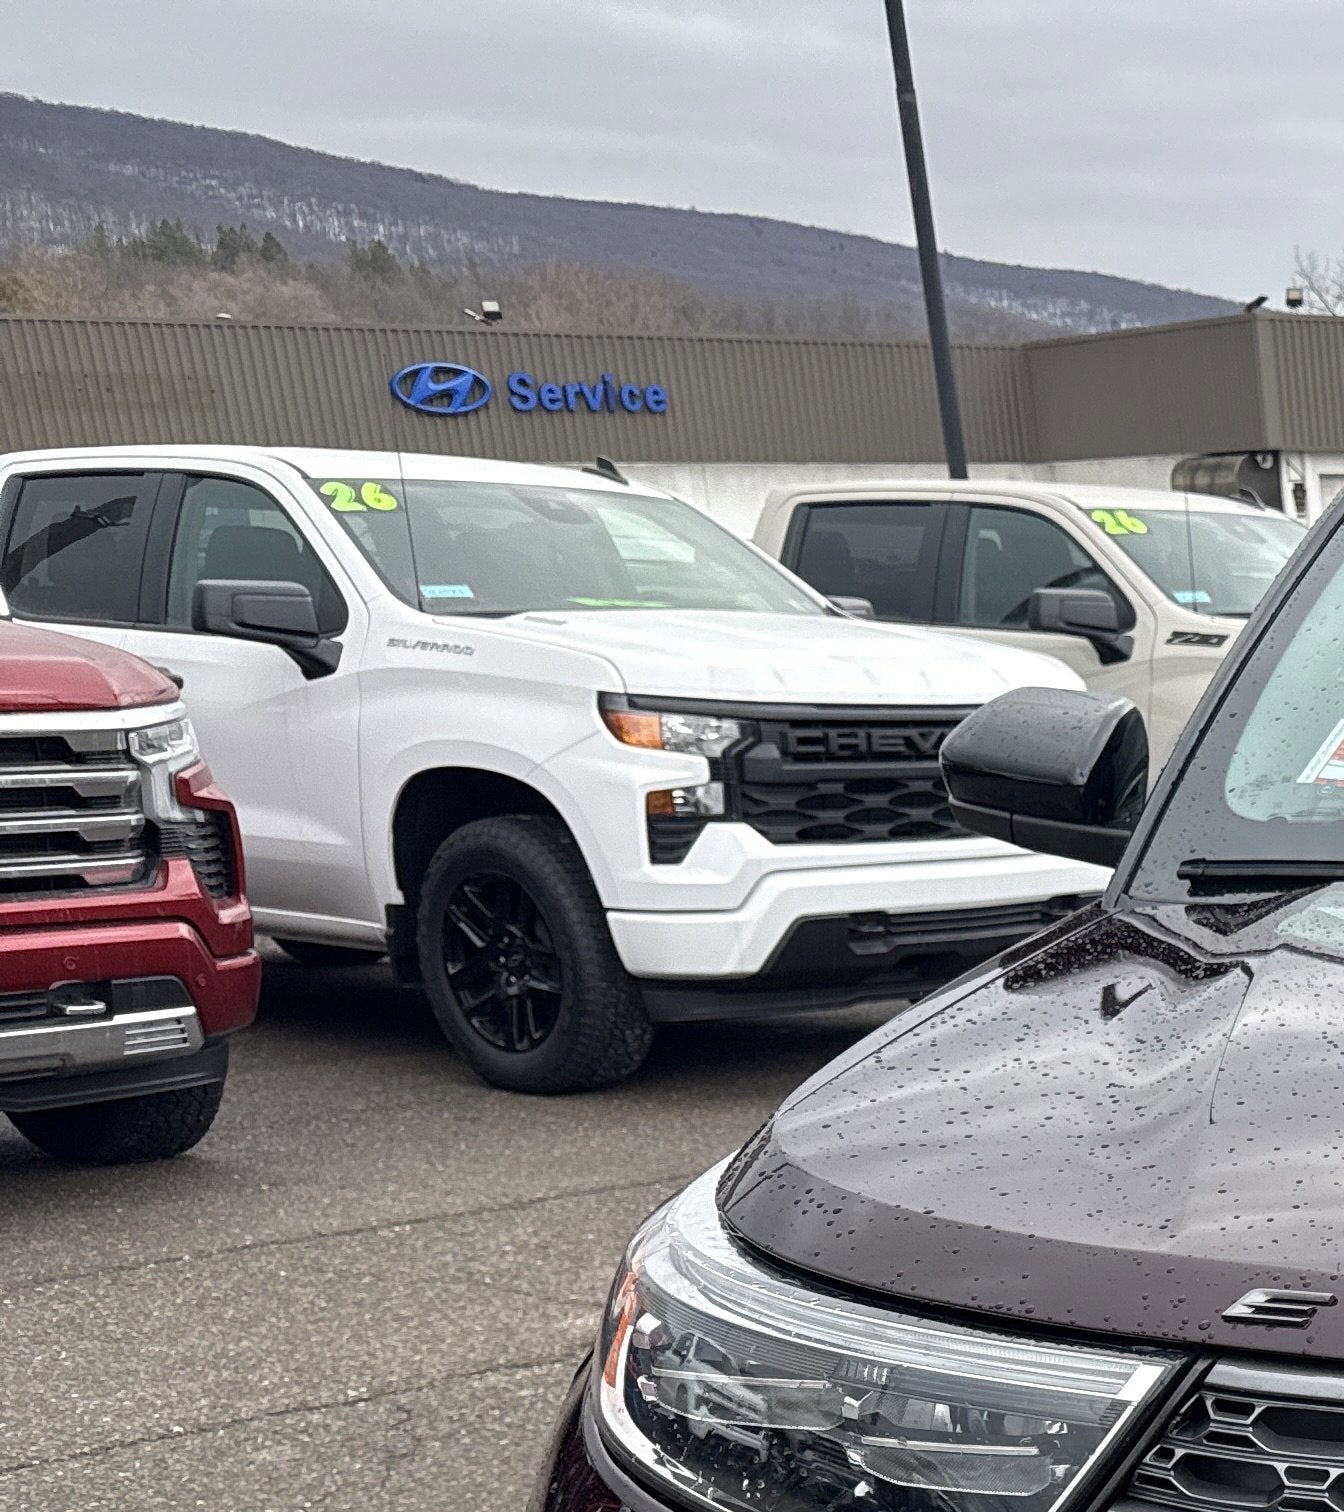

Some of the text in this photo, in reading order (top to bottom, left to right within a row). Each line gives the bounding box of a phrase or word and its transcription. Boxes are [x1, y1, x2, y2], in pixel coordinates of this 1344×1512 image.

[507, 371, 668, 413] Service
[319, 481, 398, 512] 26
[1091, 509, 1148, 535] 26
[386, 637, 476, 656] SILVERADO
